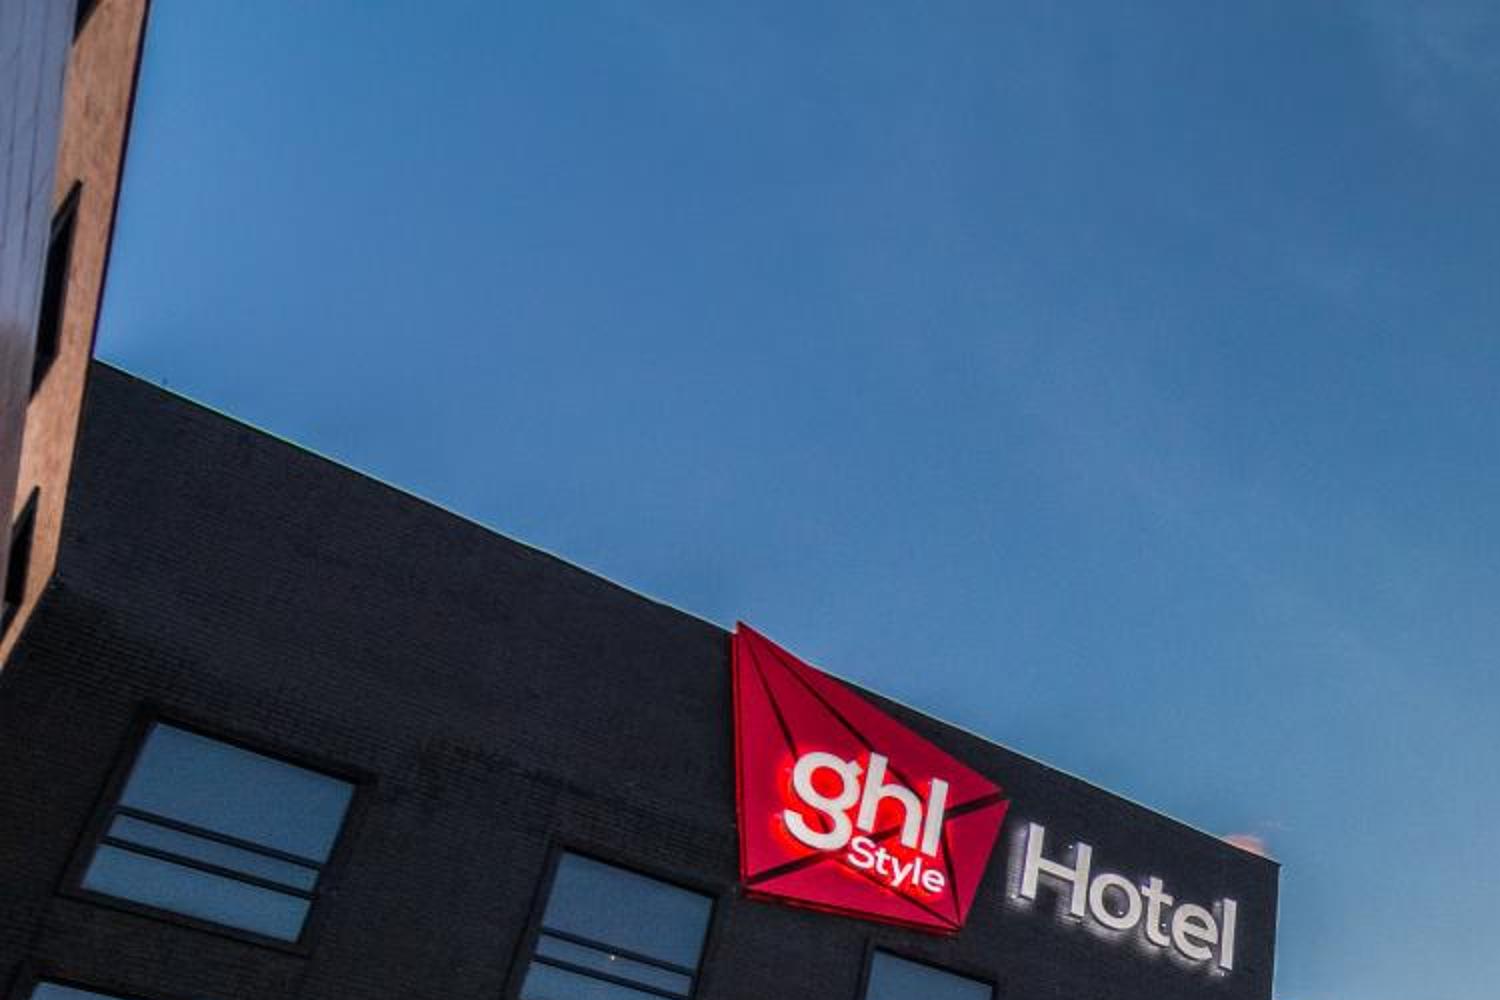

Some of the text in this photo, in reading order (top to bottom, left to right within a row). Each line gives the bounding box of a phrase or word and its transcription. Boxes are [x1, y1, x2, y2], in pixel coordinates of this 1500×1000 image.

[782, 751, 949, 857] ghl
[847, 834, 946, 894] Style
[1020, 822, 1237, 971] Hotel
